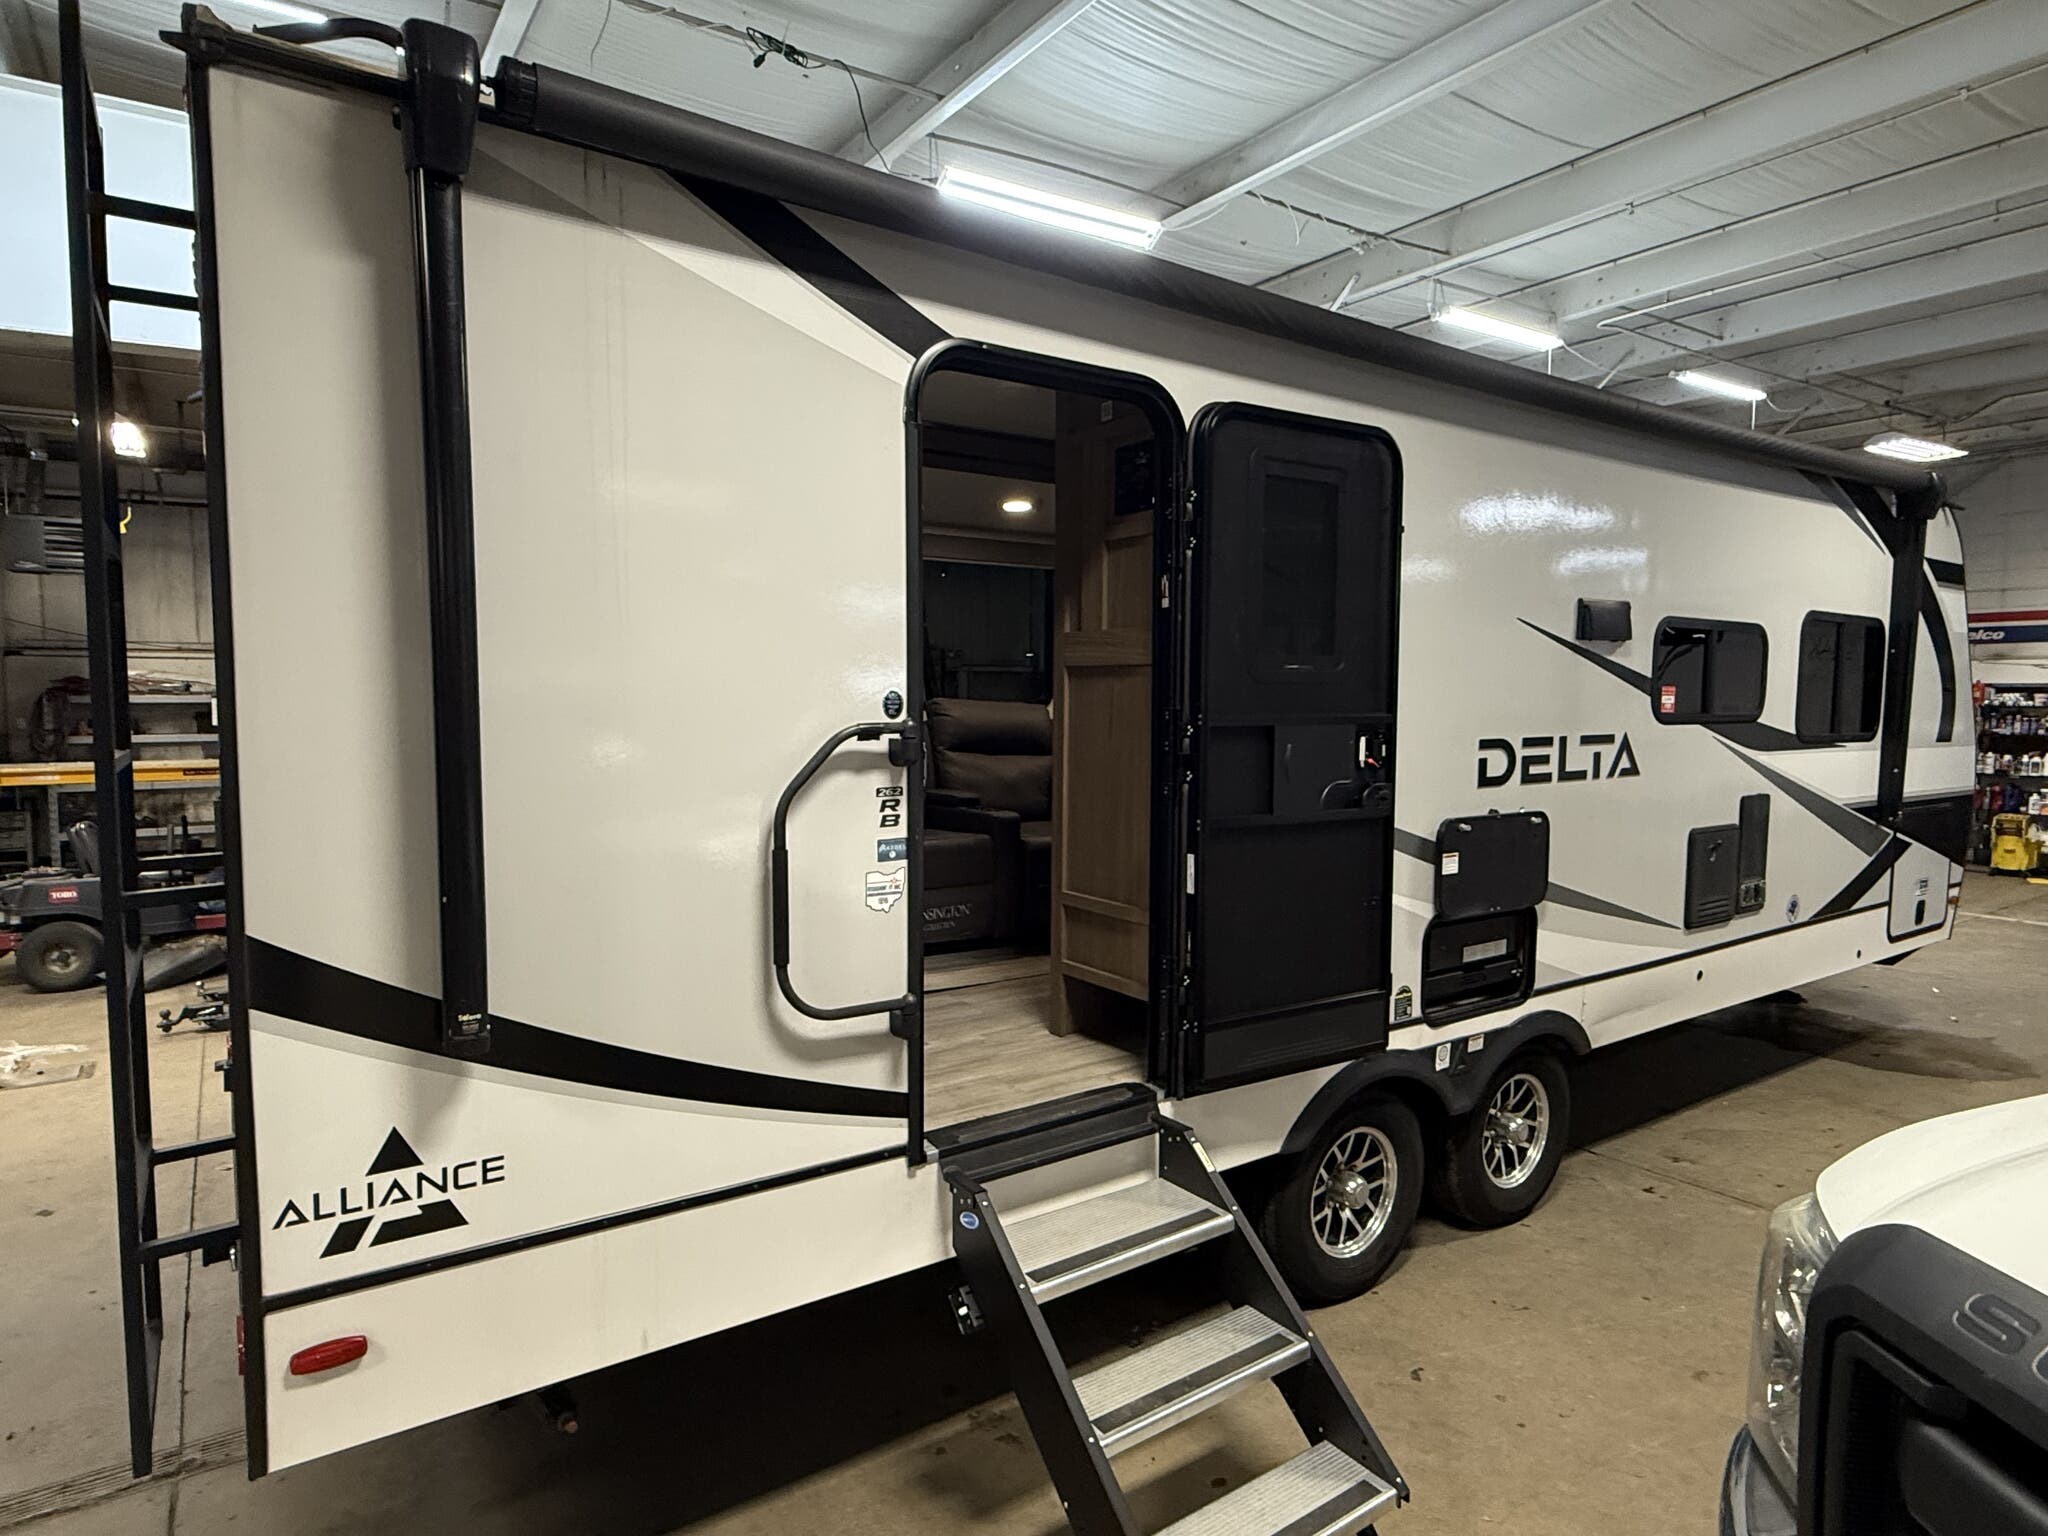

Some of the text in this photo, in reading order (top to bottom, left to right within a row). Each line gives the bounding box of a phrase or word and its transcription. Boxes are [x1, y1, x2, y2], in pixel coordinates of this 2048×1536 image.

[1477, 732, 1640, 788] DELTA
[878, 788, 902, 797] 262
[50, 891, 78, 899] TORO
[272, 1155, 506, 1230] ALLIANCE
